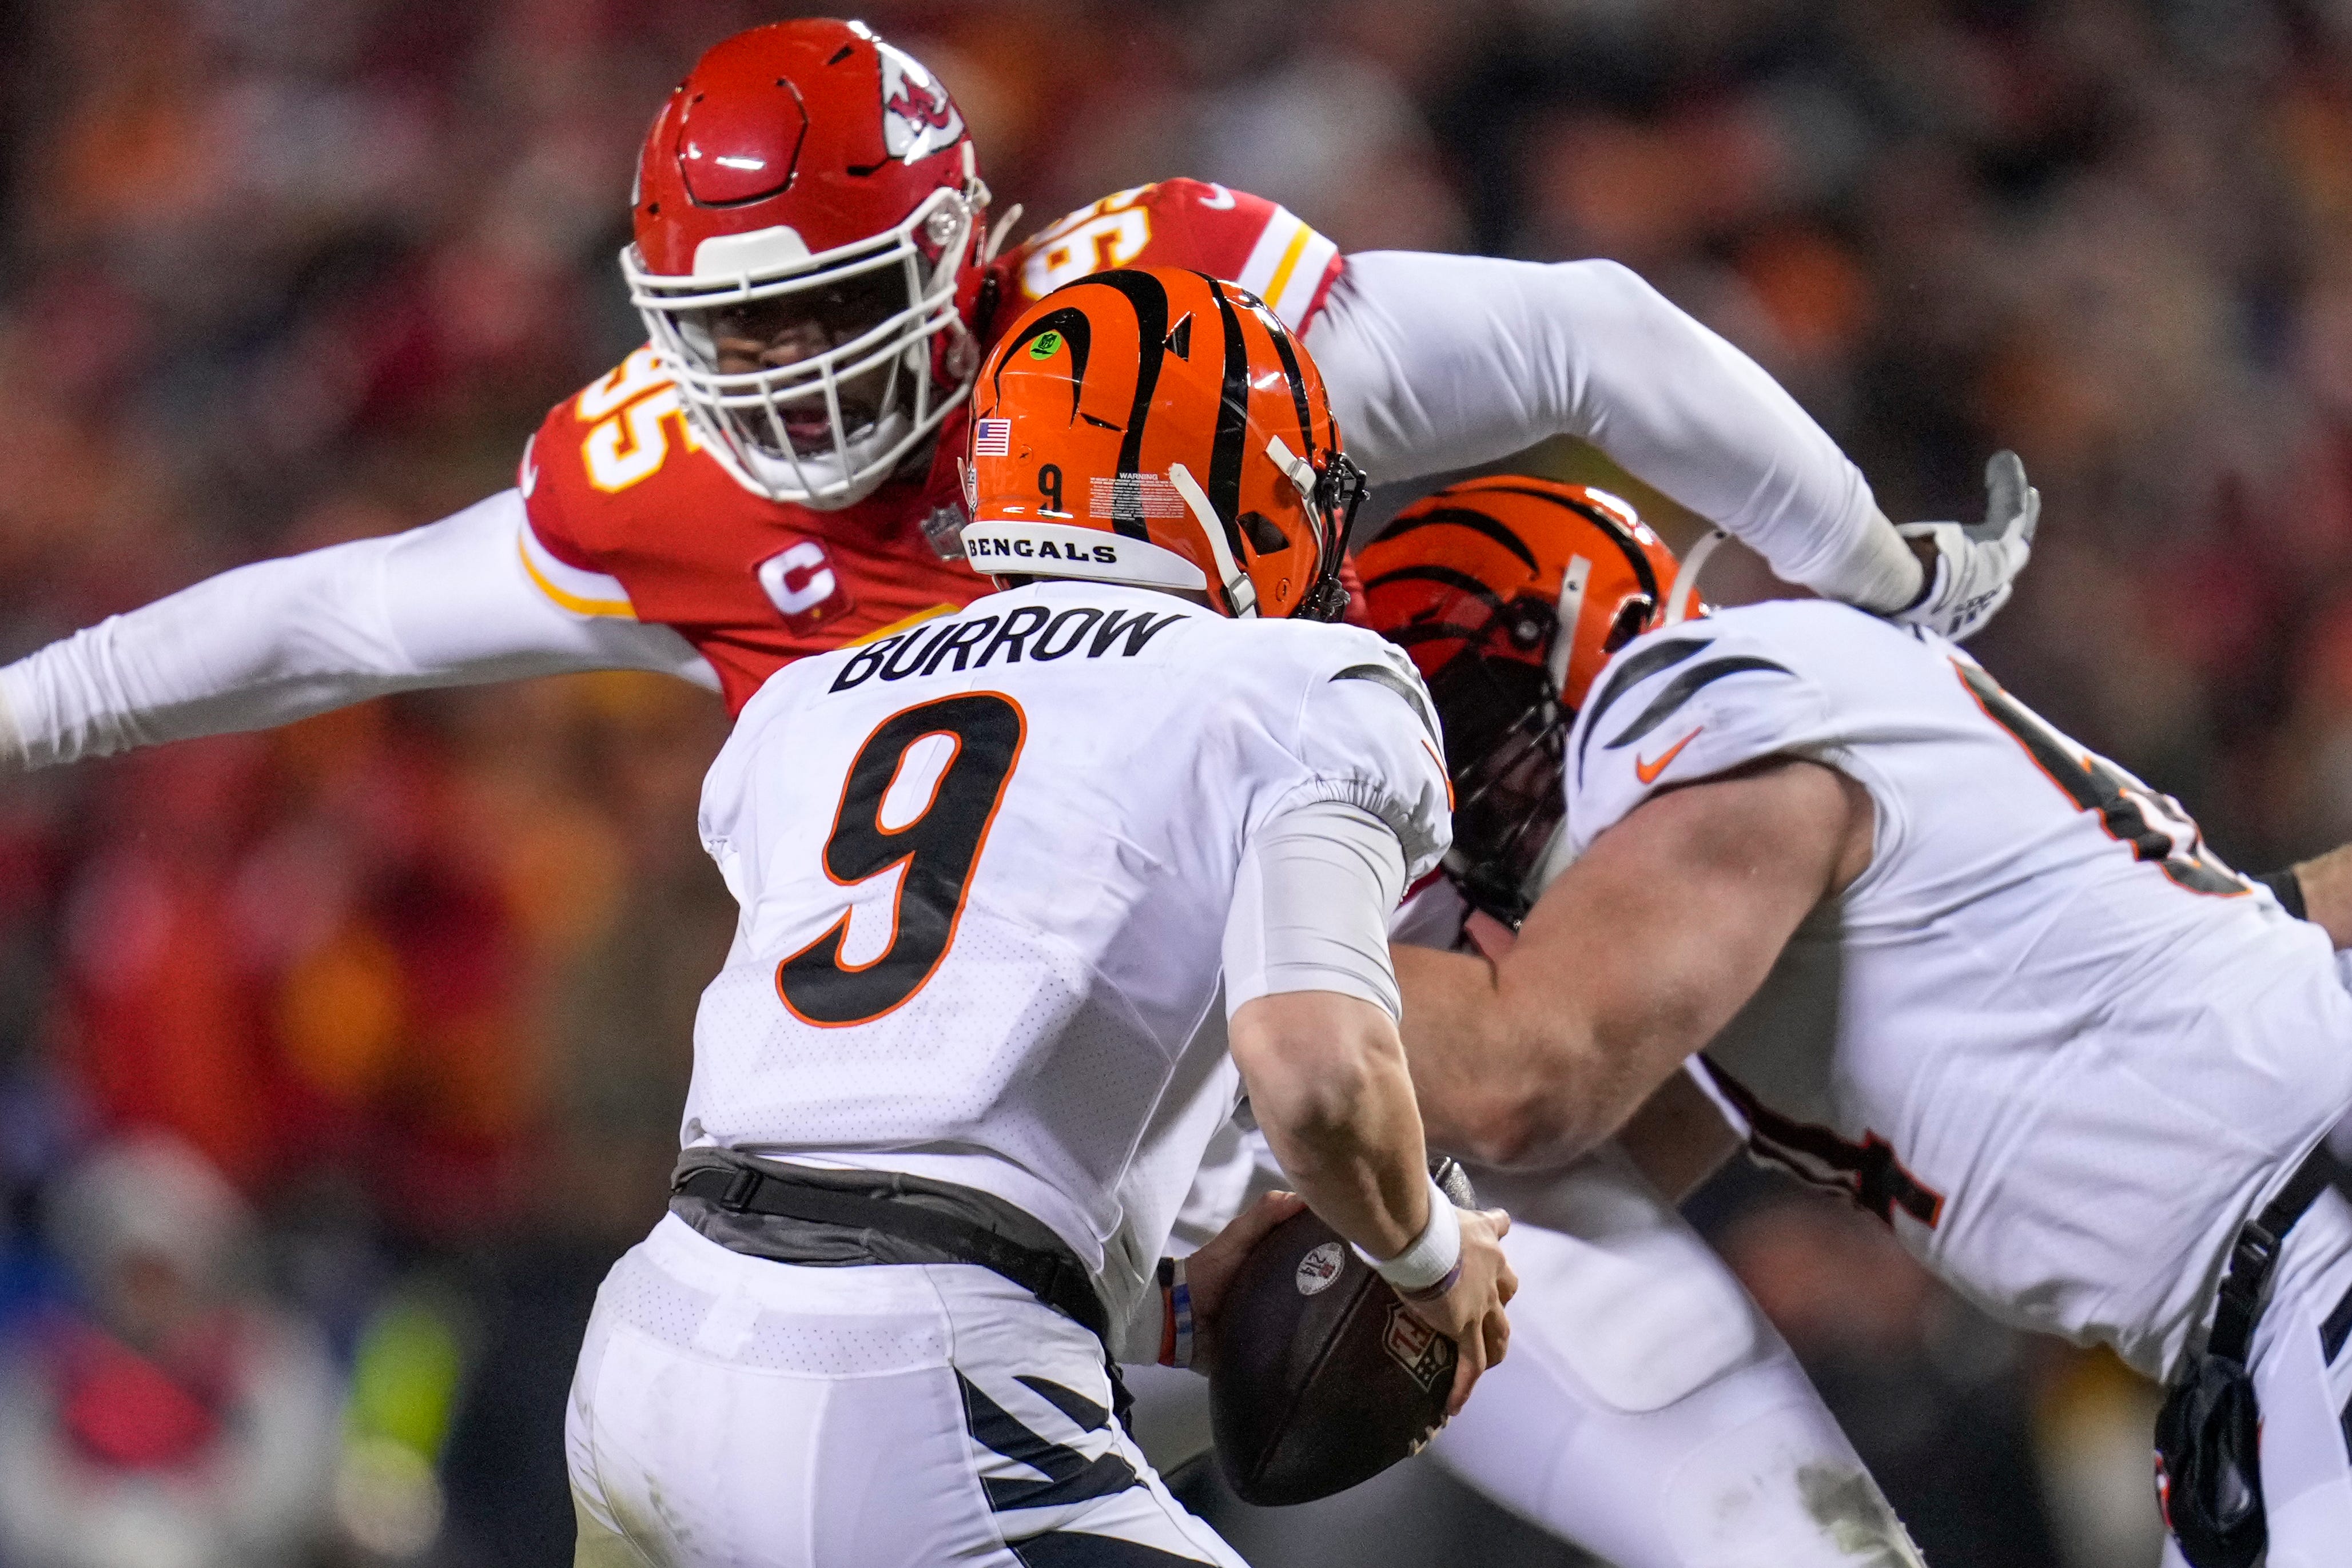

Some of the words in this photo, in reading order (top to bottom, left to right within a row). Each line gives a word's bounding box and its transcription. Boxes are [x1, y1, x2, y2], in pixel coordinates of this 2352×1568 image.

[1037, 463, 1063, 519] 9
[1119, 472, 1158, 480] WARNING
[758, 541, 836, 615] C
[967, 538, 1117, 563] BENGALS
[827, 605, 1193, 694] BURROW
[775, 690, 1028, 1028] 9
[1391, 1311, 1434, 1358] FL
